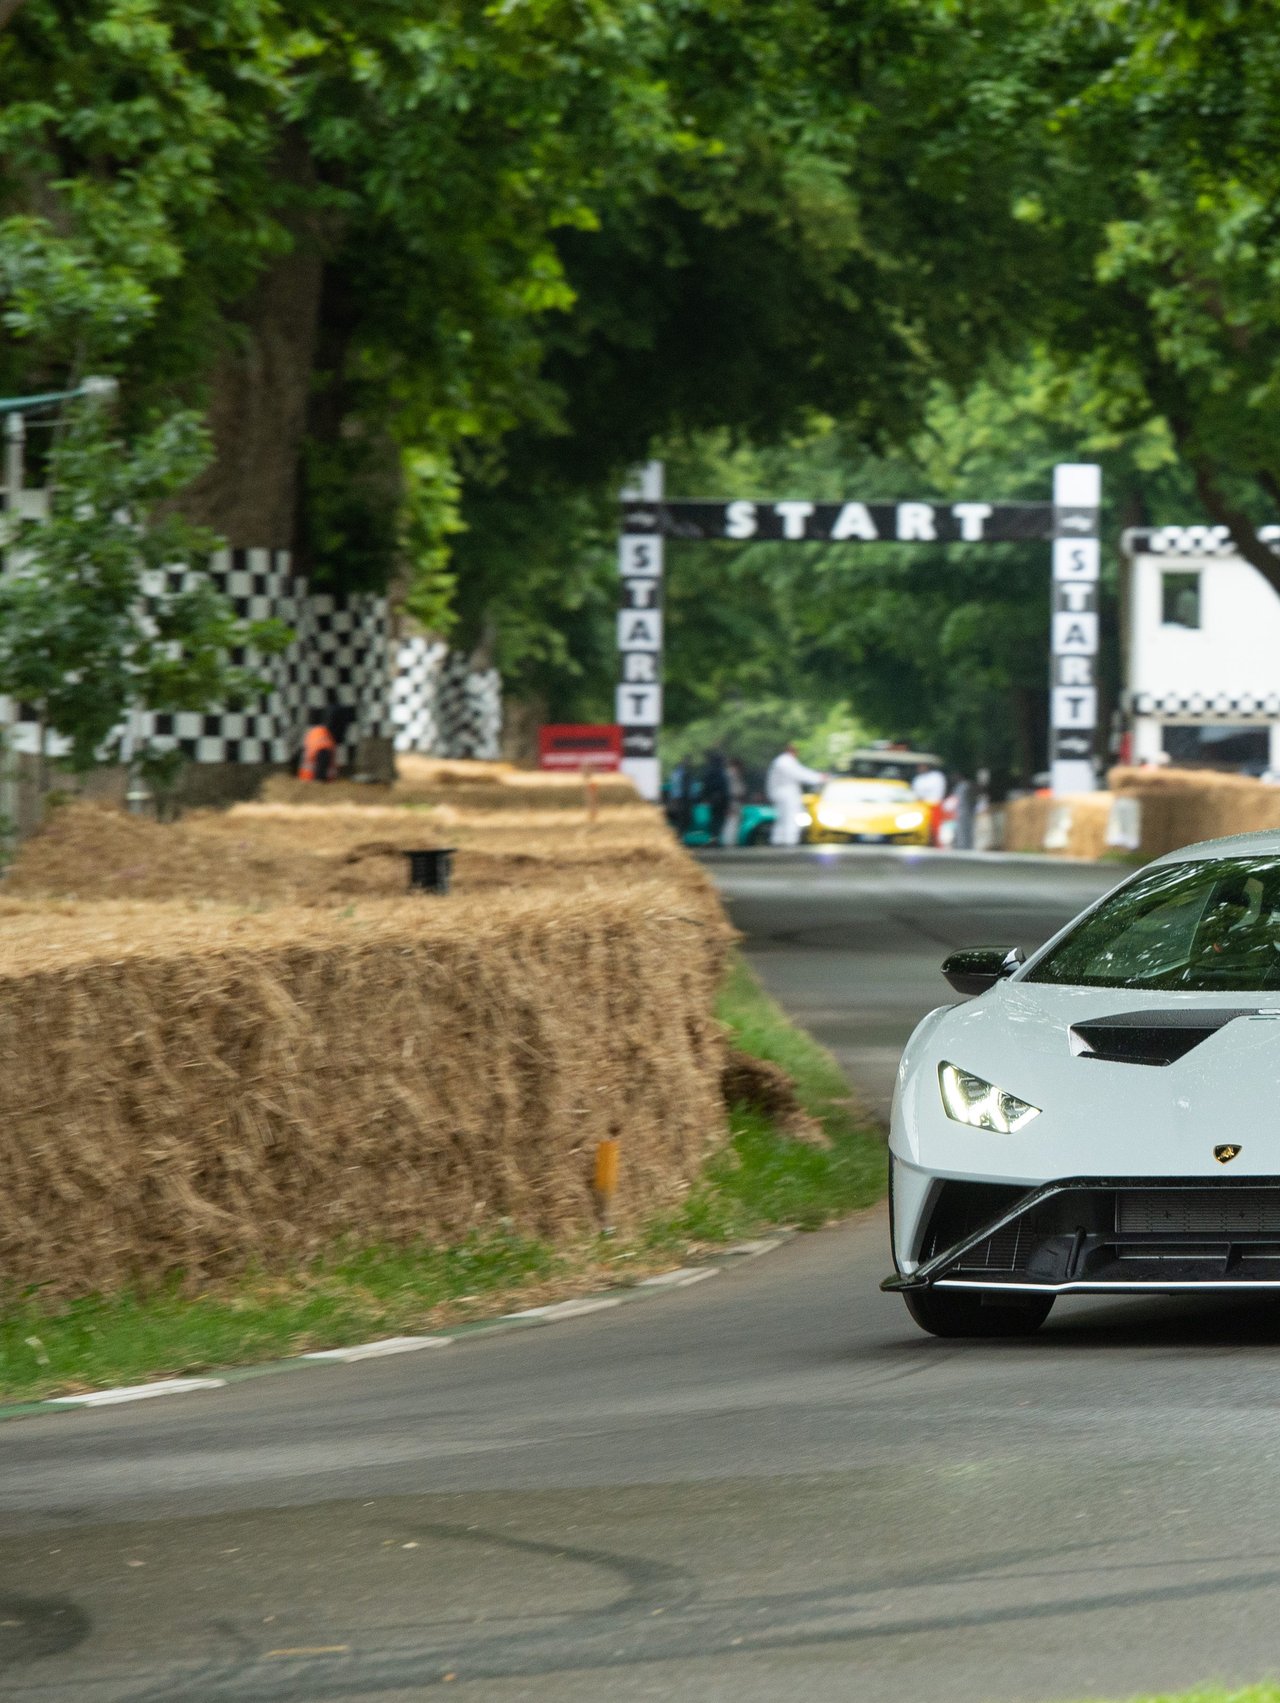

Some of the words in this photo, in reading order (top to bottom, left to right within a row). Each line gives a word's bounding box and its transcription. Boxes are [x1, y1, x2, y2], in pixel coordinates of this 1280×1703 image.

[724, 501, 994, 540] START
[623, 544, 658, 717] START
[1061, 550, 1094, 719] START
